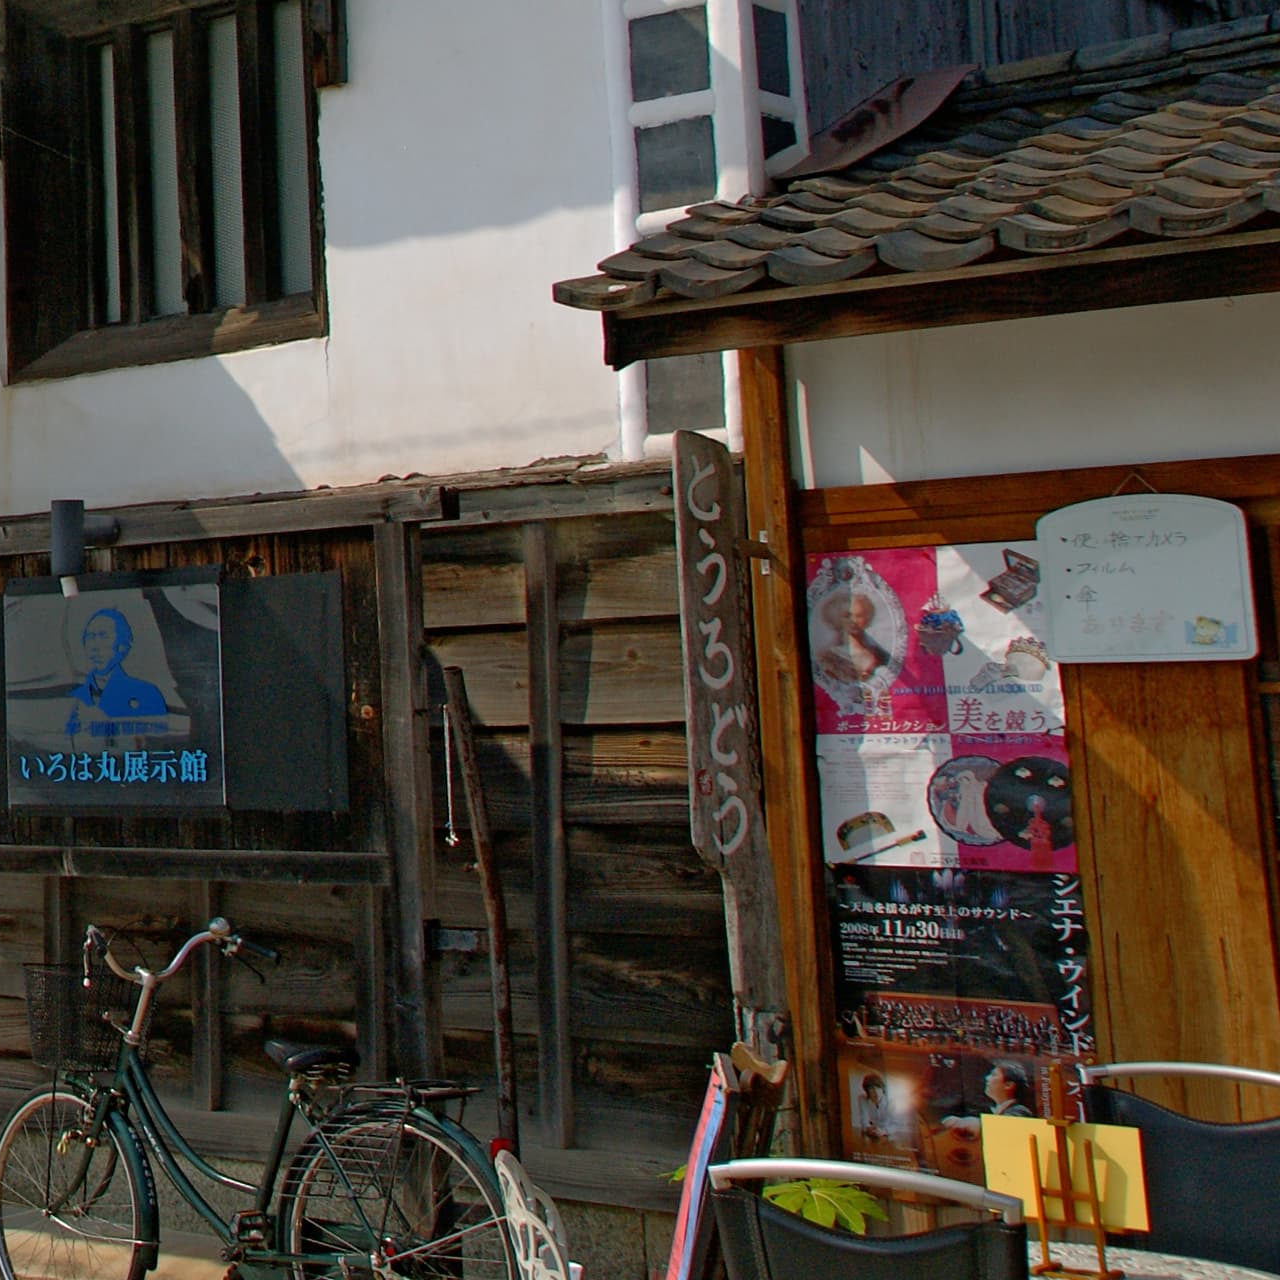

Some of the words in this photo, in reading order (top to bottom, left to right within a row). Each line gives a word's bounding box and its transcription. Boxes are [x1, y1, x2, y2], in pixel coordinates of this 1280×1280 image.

[952, 697, 1047, 732] 美を競う
[19, 748, 209, 783] いろは丸展示館
